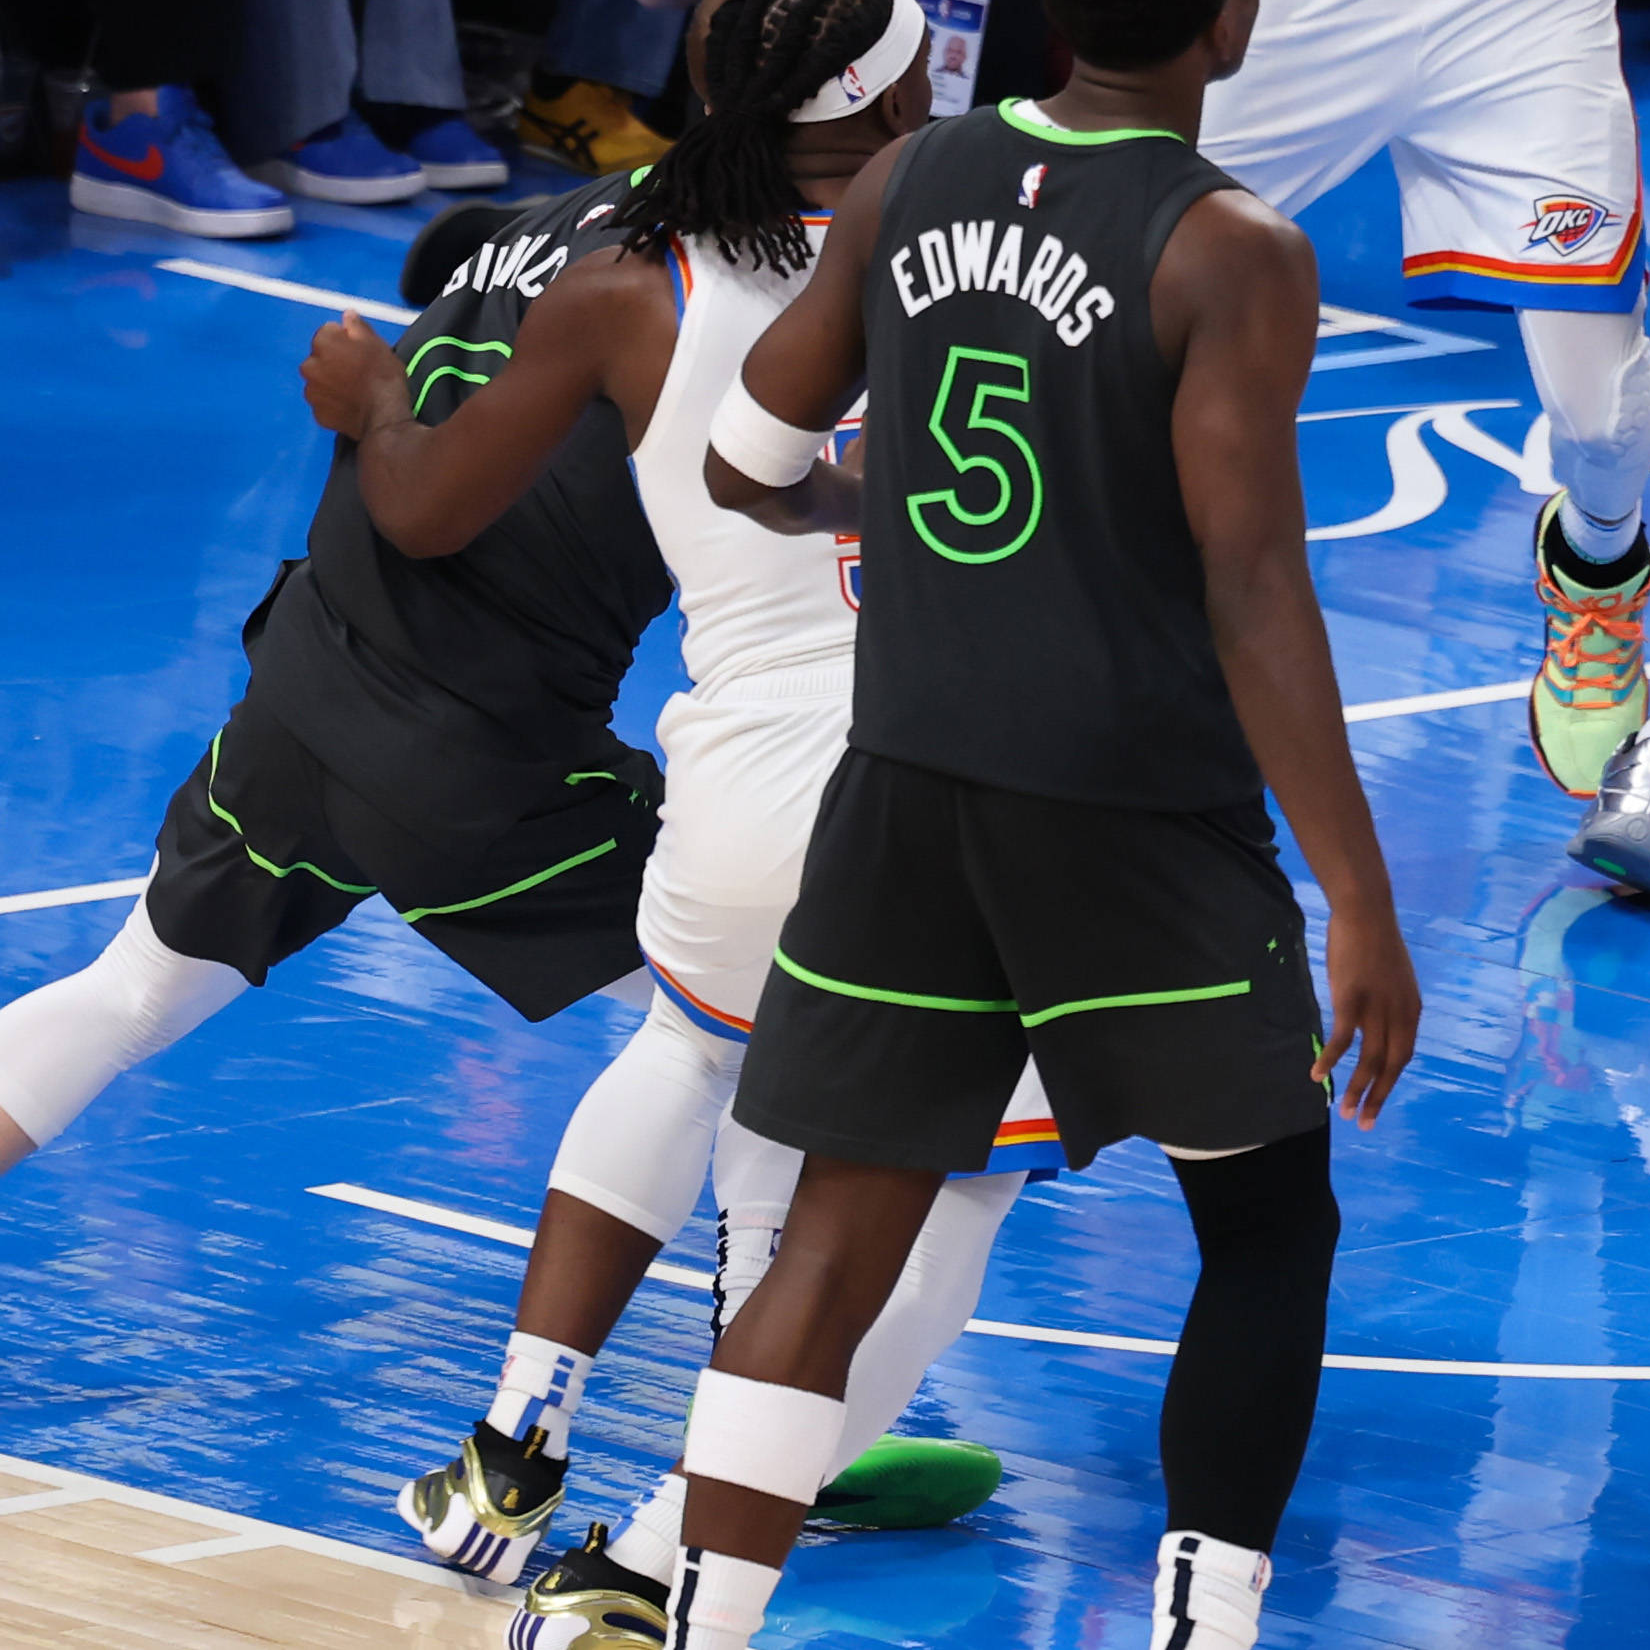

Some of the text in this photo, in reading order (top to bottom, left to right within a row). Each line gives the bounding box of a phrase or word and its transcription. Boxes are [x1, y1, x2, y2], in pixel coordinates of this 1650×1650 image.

[891, 220, 1115, 347] EDWARDS
[1529, 209, 1591, 241] OKC
[906, 346, 1043, 564] 5
